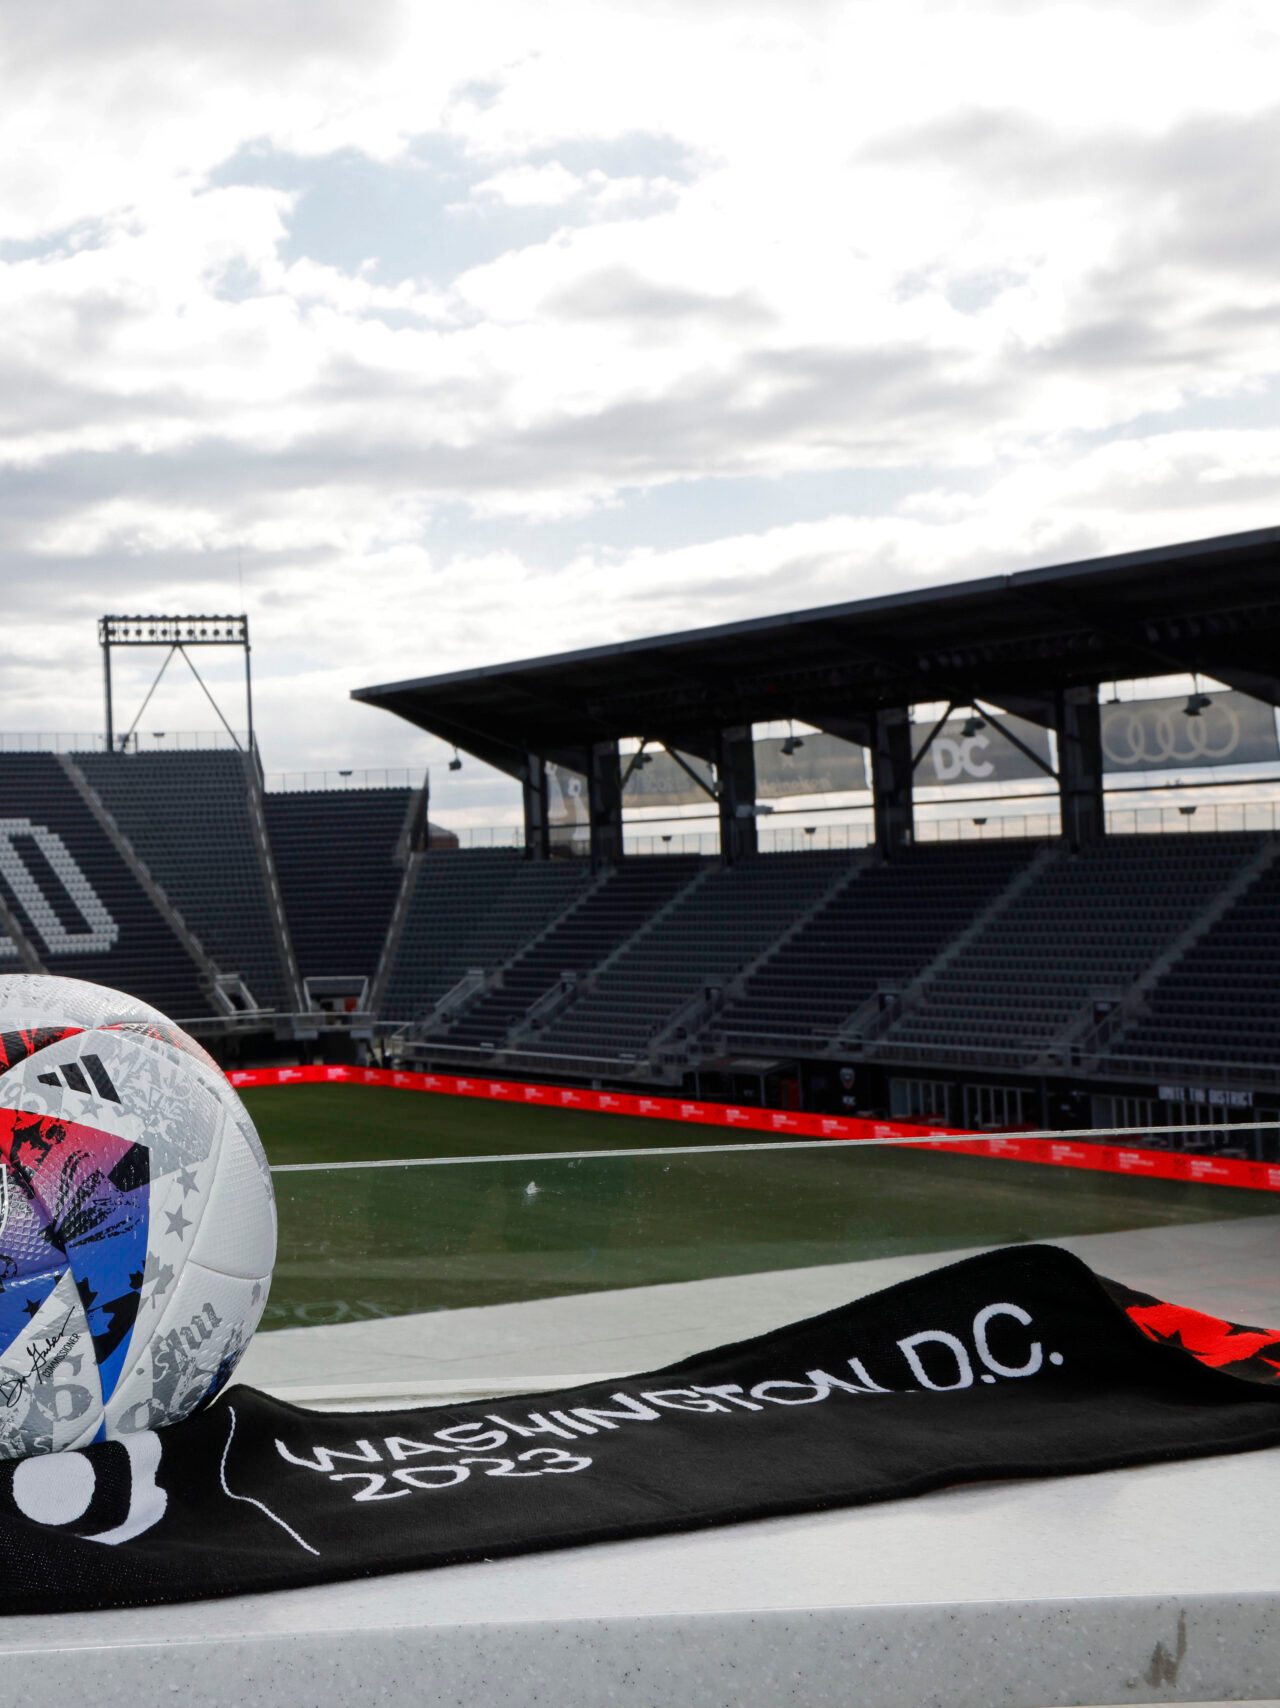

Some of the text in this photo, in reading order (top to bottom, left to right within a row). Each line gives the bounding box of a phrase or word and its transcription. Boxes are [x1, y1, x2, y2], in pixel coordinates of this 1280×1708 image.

[42, 1332, 81, 1378] COMMISSIONER
[274, 1302, 1064, 1472] WASHINGTON D.C.
[328, 1448, 593, 1502] 2023
